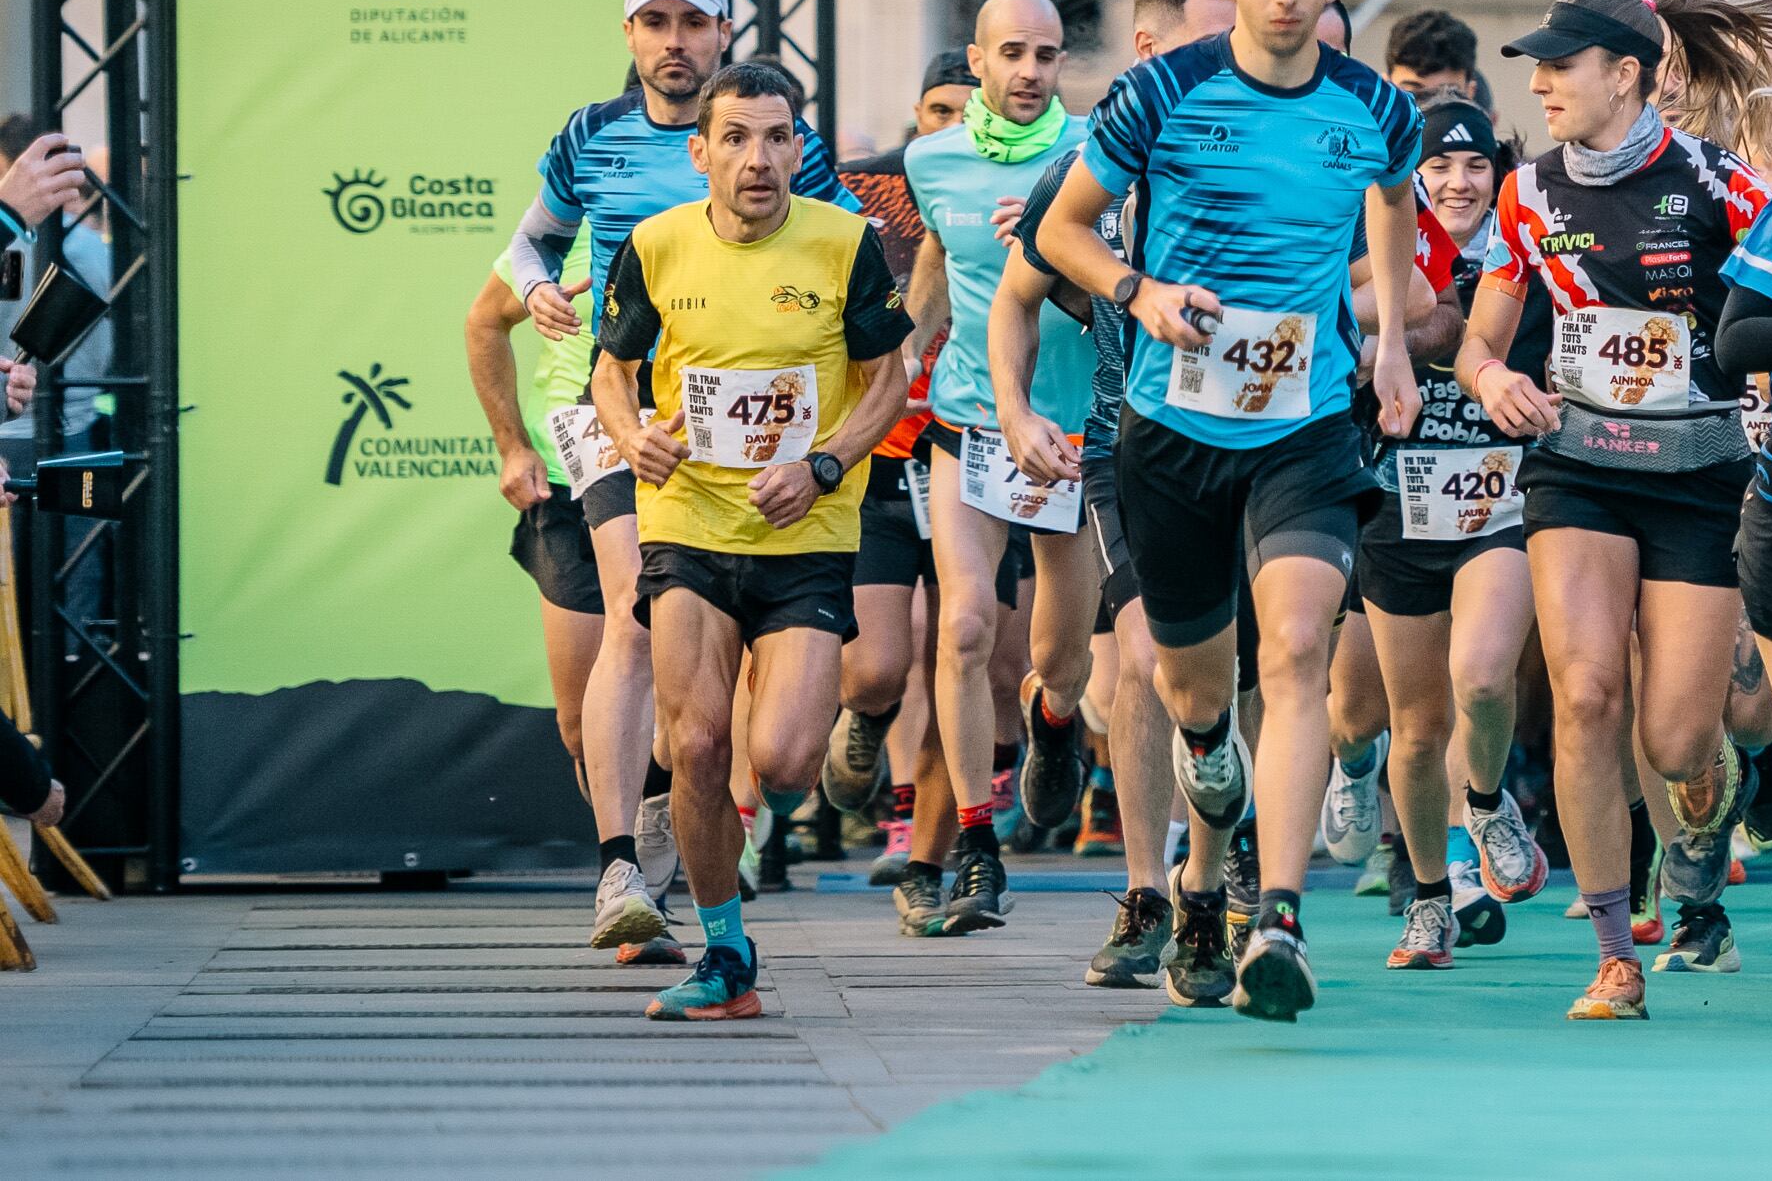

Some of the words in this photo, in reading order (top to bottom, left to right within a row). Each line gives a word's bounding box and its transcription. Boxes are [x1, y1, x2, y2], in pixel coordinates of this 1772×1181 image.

[350, 7, 466, 23] DIPUTACIÓN
[350, 29, 371, 43] DE
[380, 28, 467, 43] ALICANTE
[1200, 142, 1240, 154] VIATOR
[409, 175, 494, 195] Costa
[391, 197, 494, 219] Blanca
[1541, 233, 1595, 252] TRIVICI
[1645, 240, 1690, 250] FRANCES
[671, 297, 706, 310] GOBIK
[1577, 313, 1598, 324] TRAIL
[1562, 322, 1579, 333] FIRA
[1582, 324, 1592, 334] DE
[1562, 333, 1582, 344] TOTS
[1223, 338, 1296, 373] 432
[1561, 344, 1587, 355] SANTS
[1598, 334, 1668, 368] 485
[1673, 355, 1683, 370] 8K
[700, 375, 721, 386] TRAIL
[1610, 375, 1655, 387] AINHOA
[688, 384, 704, 395] FIRA
[707, 386, 717, 396] DE
[1241, 383, 1273, 393] JOAN
[689, 394, 707, 405] TOTS
[690, 405, 713, 416] SANTS
[727, 393, 795, 425] 475
[802, 405, 812, 420] 8K
[1422, 402, 1456, 418] ser
[1419, 417, 1491, 445] poble
[745, 433, 781, 444] DAVID
[360, 437, 496, 457] COMUNITAT
[968, 444, 984, 454] FIRA
[987, 446, 996, 455] DE
[967, 452, 985, 463] TOTS
[355, 458, 498, 478] VALENCIANA
[1405, 466, 1423, 475] FIRA
[1406, 476, 1424, 484] TOTS
[1441, 470, 1506, 500] 420
[1407, 485, 1430, 494] SANTS
[1010, 492, 1048, 506] CARLOS
[1458, 507, 1492, 517] LAURA
